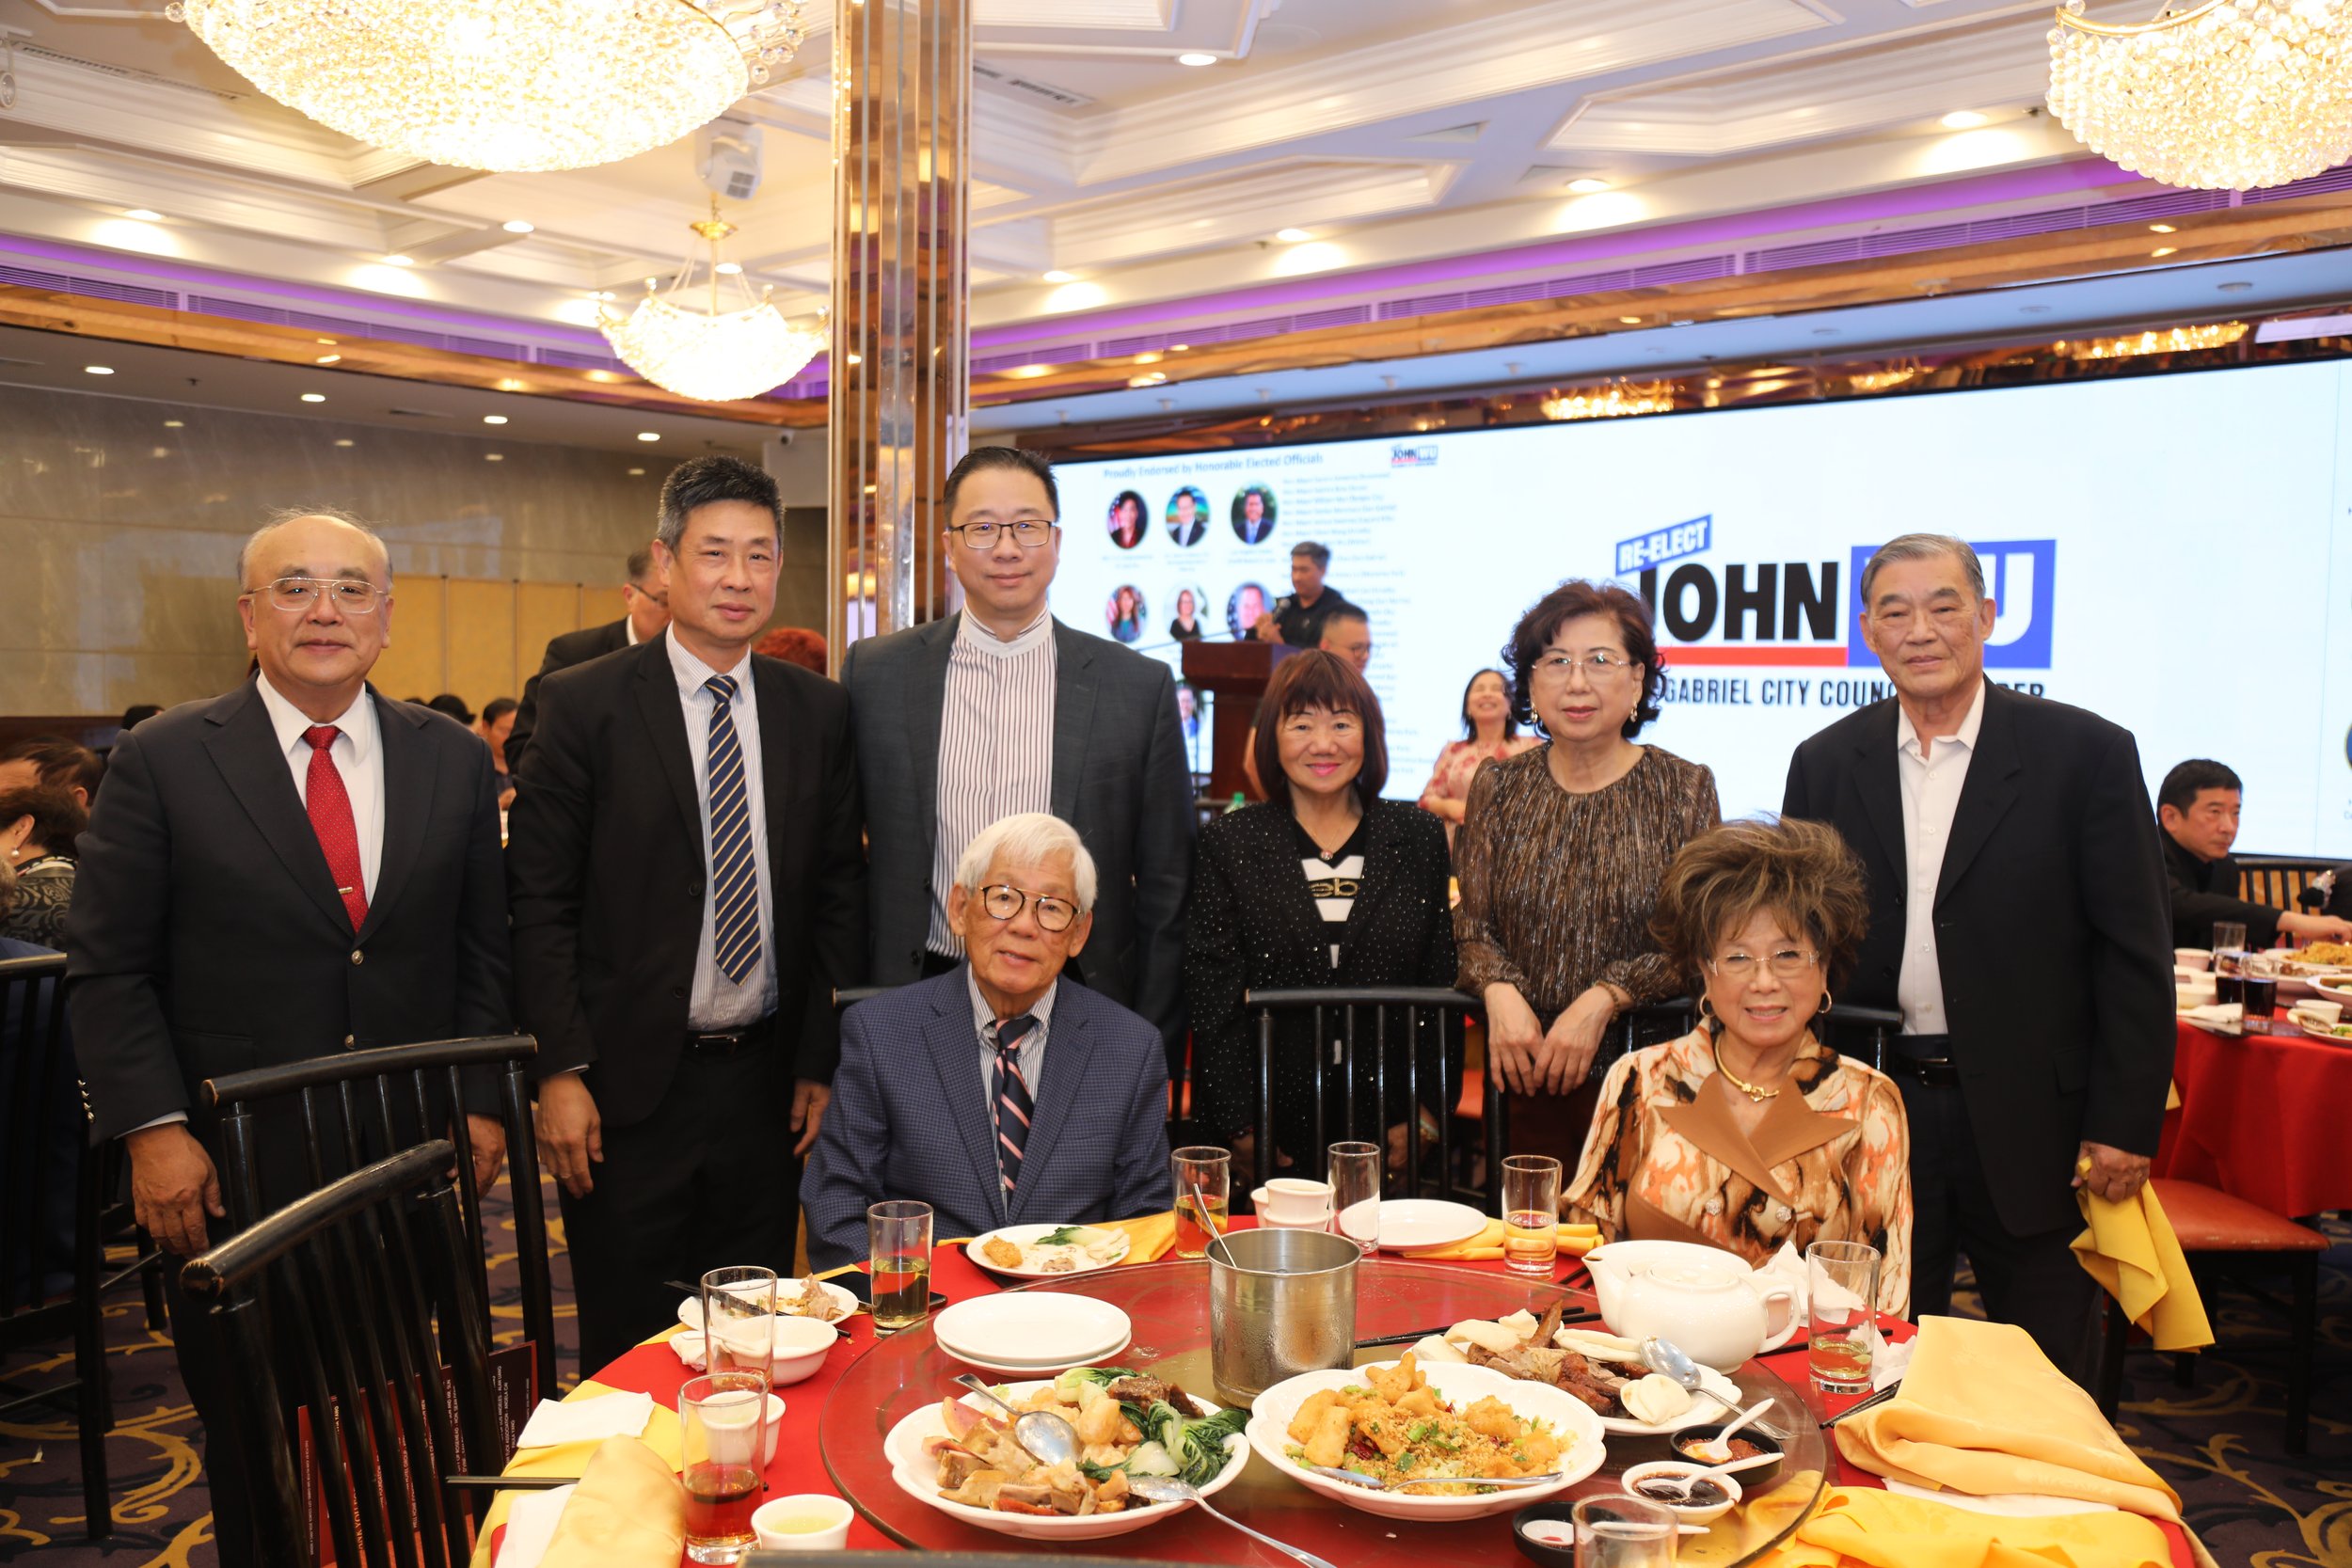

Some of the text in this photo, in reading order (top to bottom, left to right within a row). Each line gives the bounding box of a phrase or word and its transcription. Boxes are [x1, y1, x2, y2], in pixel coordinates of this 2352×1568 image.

[1104, 453, 1323, 479] Proudly Endorsed by Honorable Elected Officials
[1619, 519, 1708, 572] RE-ELECT
[1664, 678, 1753, 705] GABRIEL
[1762, 679, 1811, 705] CITY
